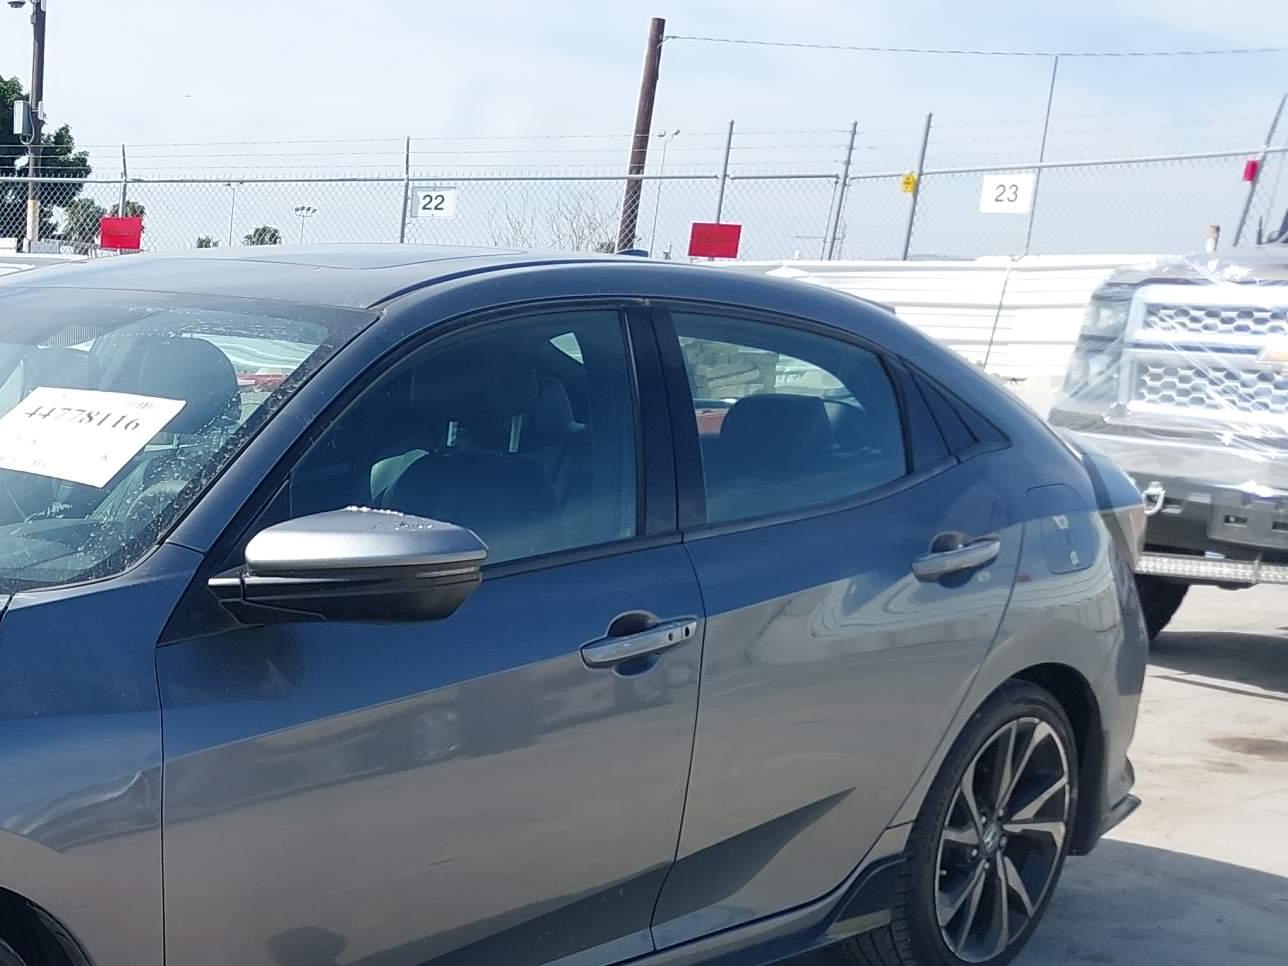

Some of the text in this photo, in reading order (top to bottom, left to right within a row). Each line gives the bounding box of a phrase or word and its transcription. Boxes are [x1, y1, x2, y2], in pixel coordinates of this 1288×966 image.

[421, 194, 445, 211] 22
[994, 184, 1019, 203] 23
[24, 405, 141, 432] 44778116
